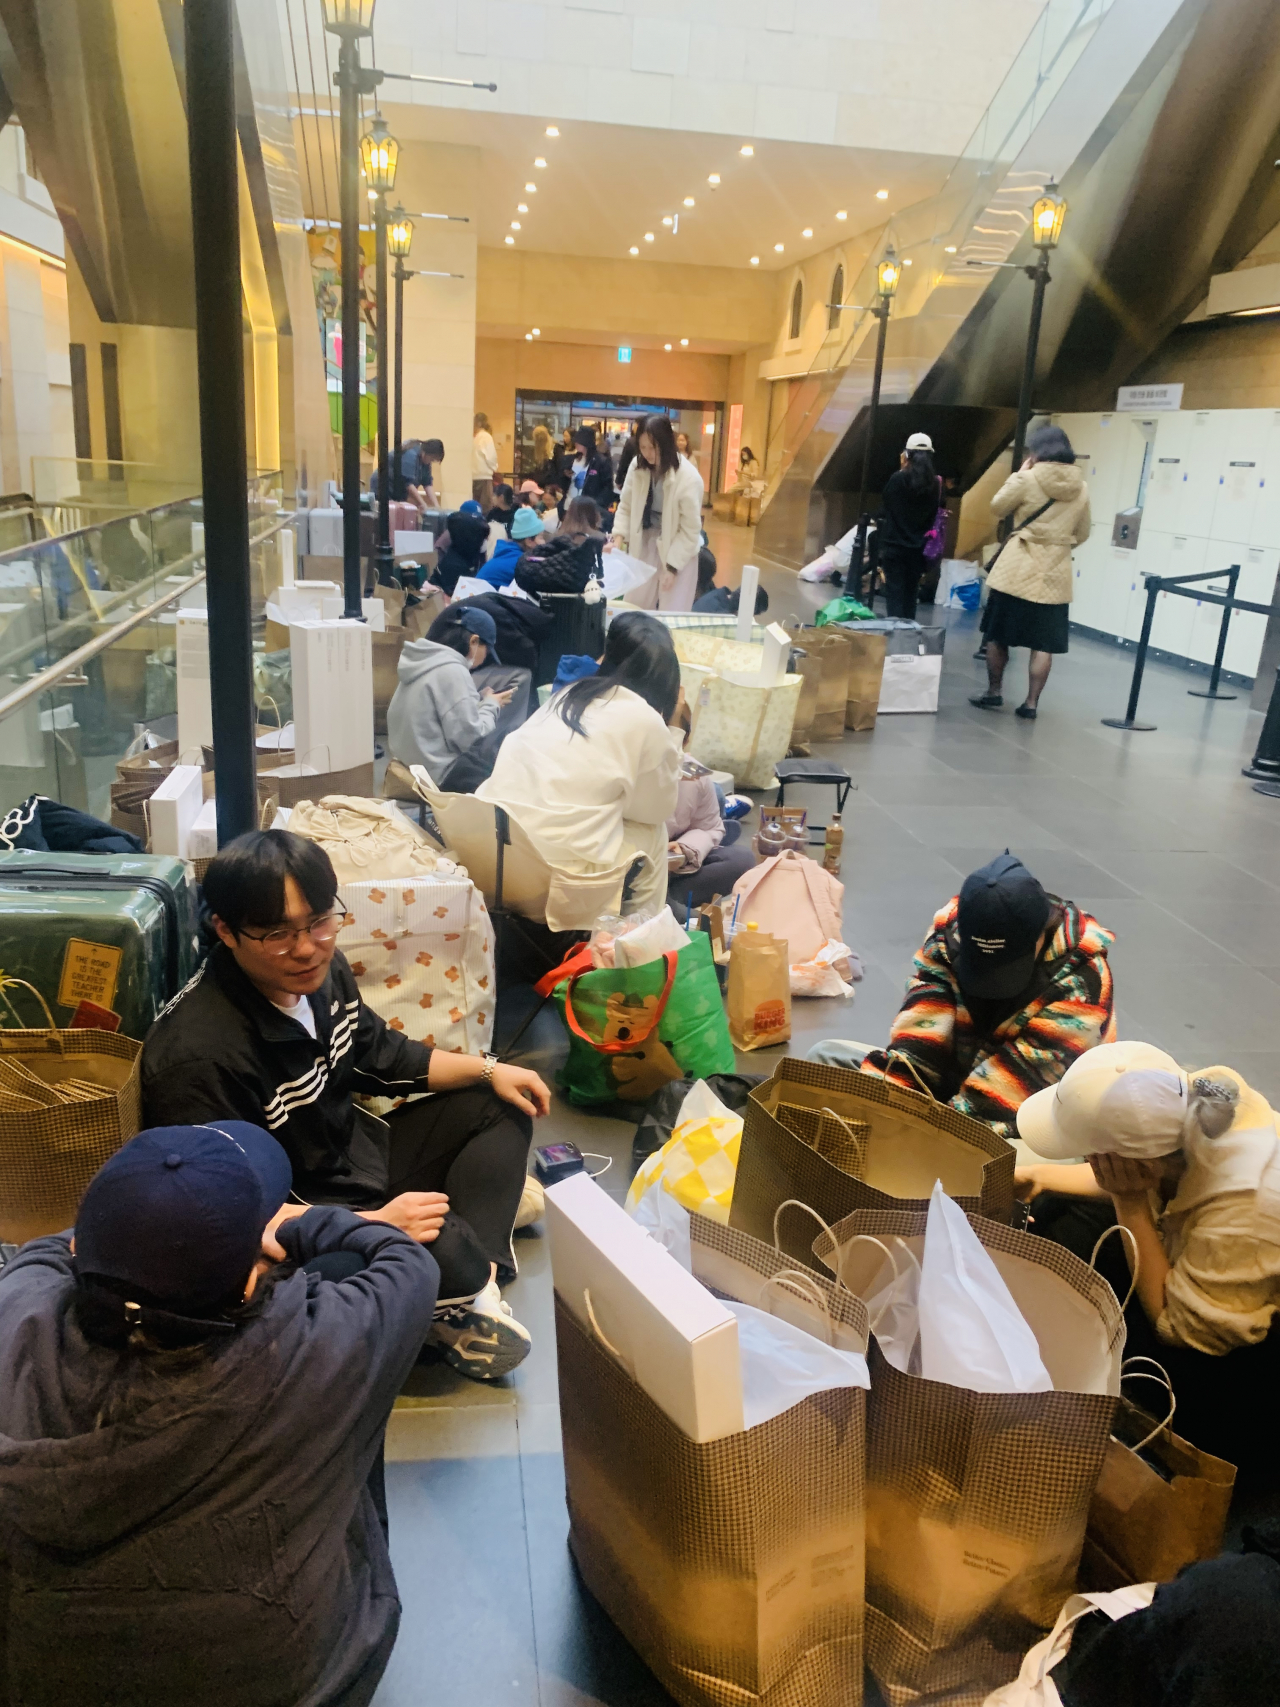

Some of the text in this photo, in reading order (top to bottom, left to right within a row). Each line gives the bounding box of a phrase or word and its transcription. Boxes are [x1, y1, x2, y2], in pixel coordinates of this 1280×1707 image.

[76, 955, 111, 969] THE ROAD
[80, 965, 102, 976] IS THE
[72, 972, 107, 985] GREATEST
[72, 981, 105, 993] TEACHER
[71, 989, 103, 1002] THERE IS
[754, 1007, 786, 1020] BURGER
[754, 1016, 786, 1031] KING
